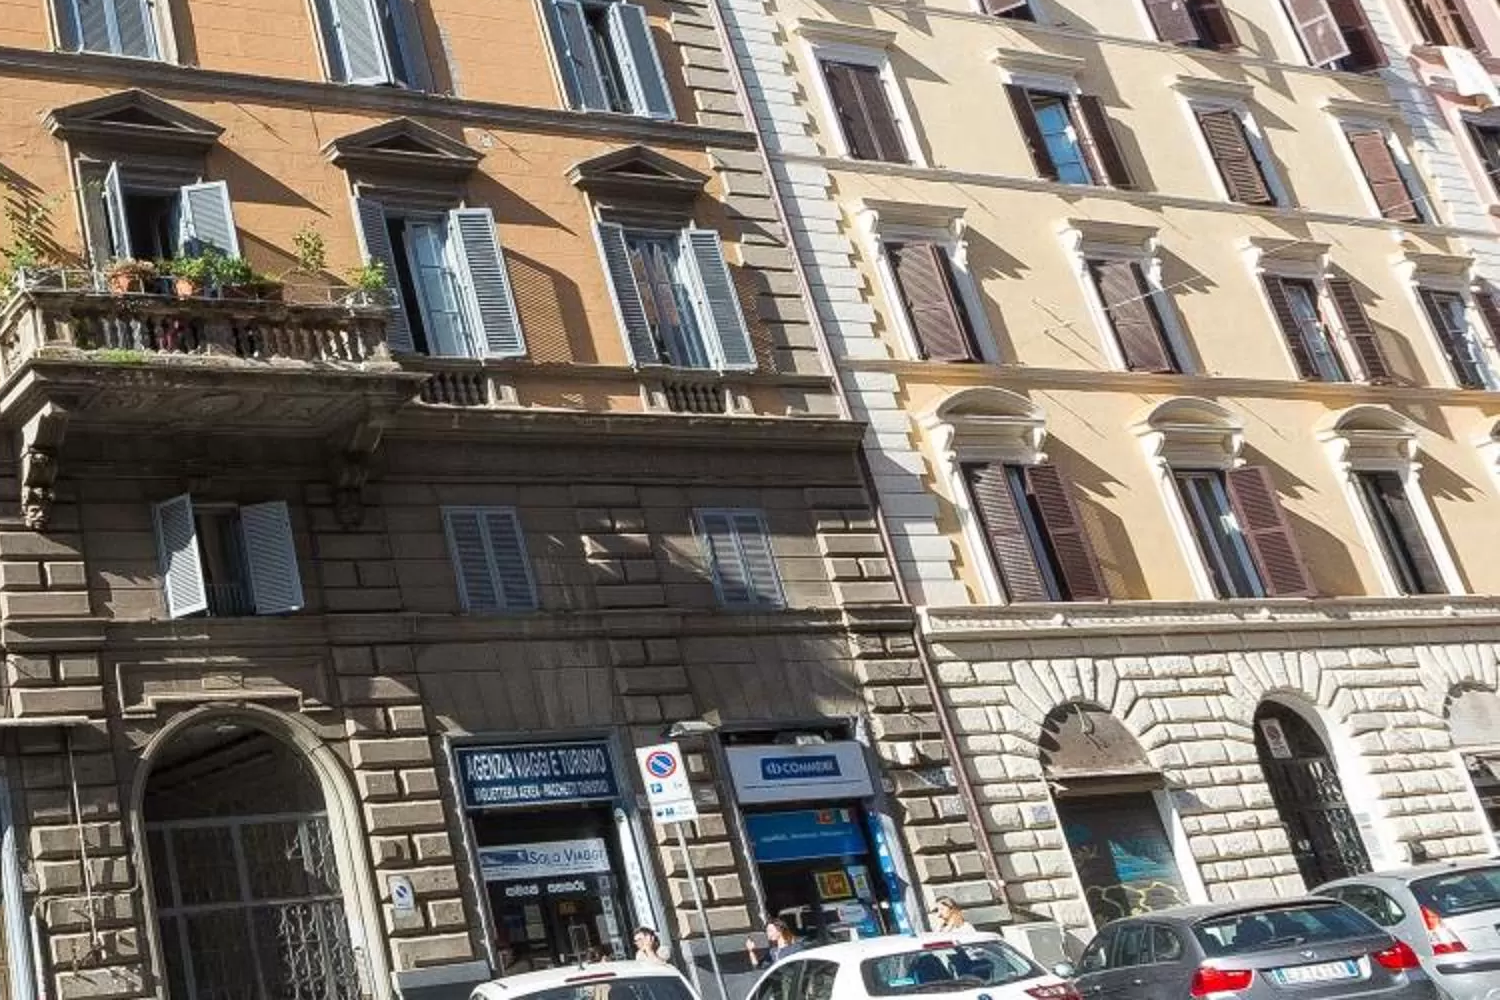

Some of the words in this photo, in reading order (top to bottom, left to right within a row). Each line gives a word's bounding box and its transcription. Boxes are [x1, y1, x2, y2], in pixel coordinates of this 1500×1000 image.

[465, 753, 514, 780] AGENZIA
[512, 751, 550, 777] VIAGGI
[550, 751, 560, 776] E
[560, 748, 606, 775] TURISMO
